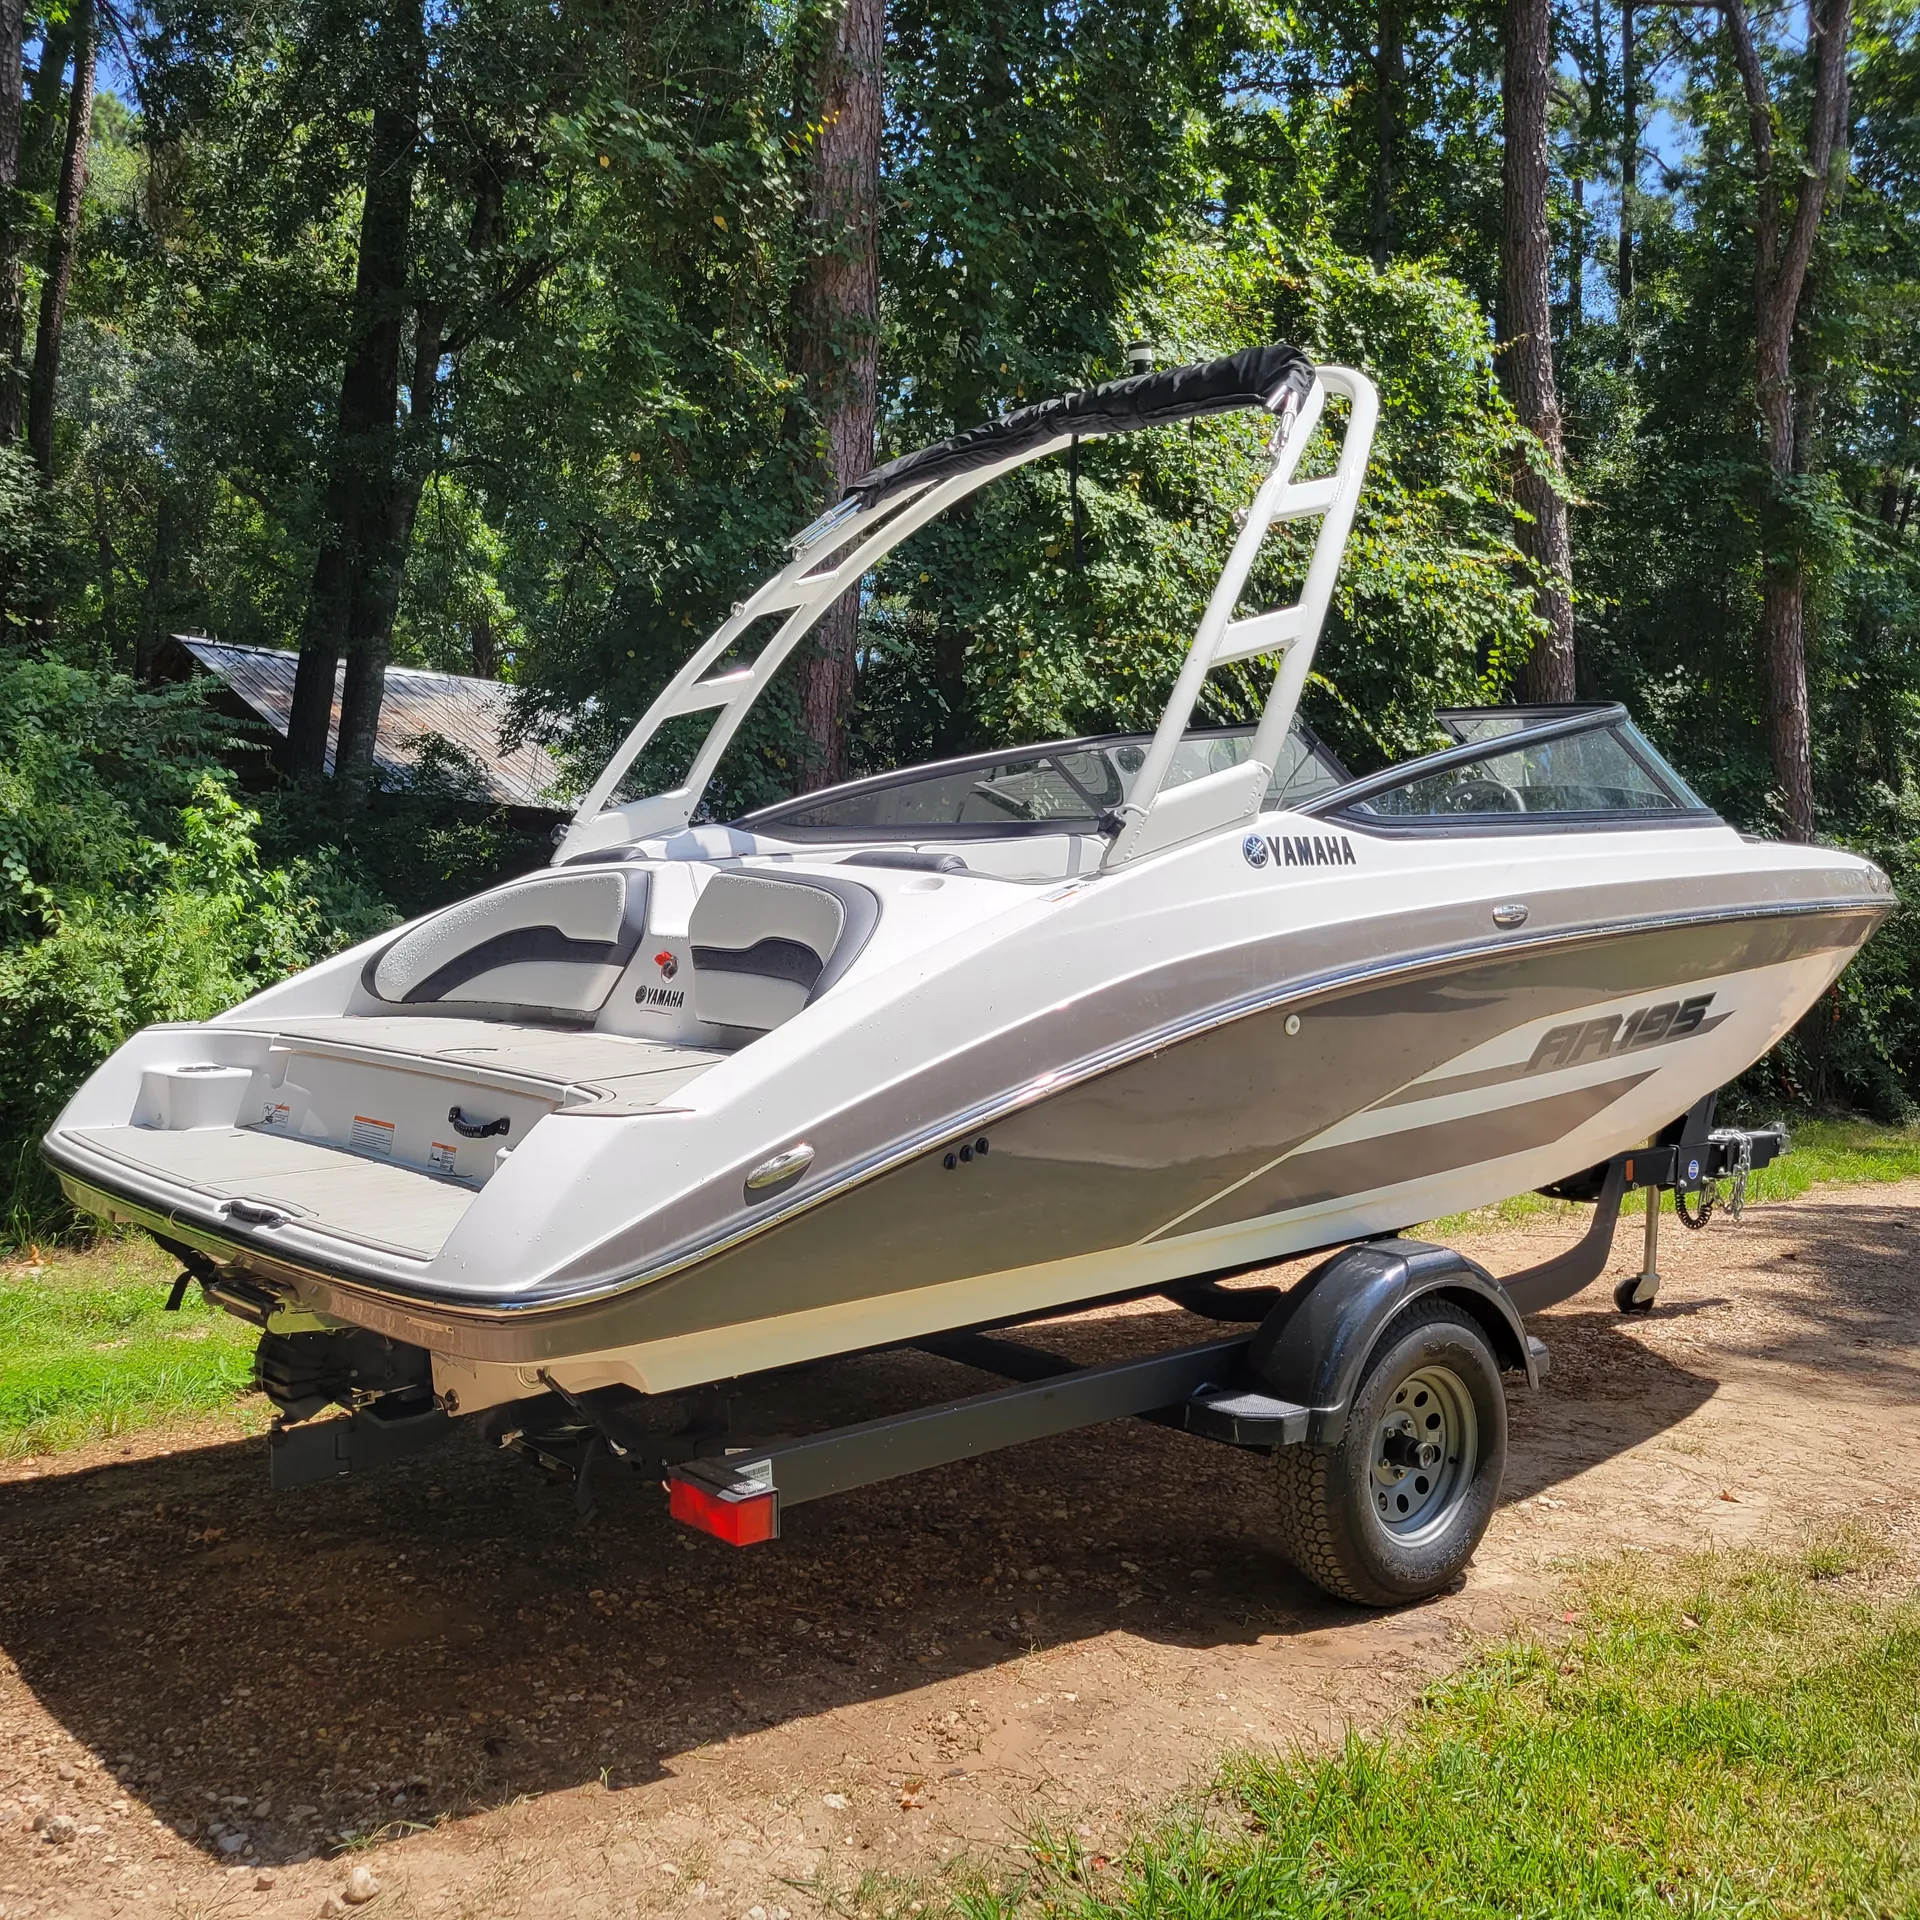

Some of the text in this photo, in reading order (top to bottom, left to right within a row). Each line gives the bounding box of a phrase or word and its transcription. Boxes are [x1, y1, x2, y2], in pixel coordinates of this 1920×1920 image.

[1266, 836, 1357, 867] YAMAHA
[646, 987, 684, 1008] YAMAHA
[1524, 991, 1718, 1072] AR195
